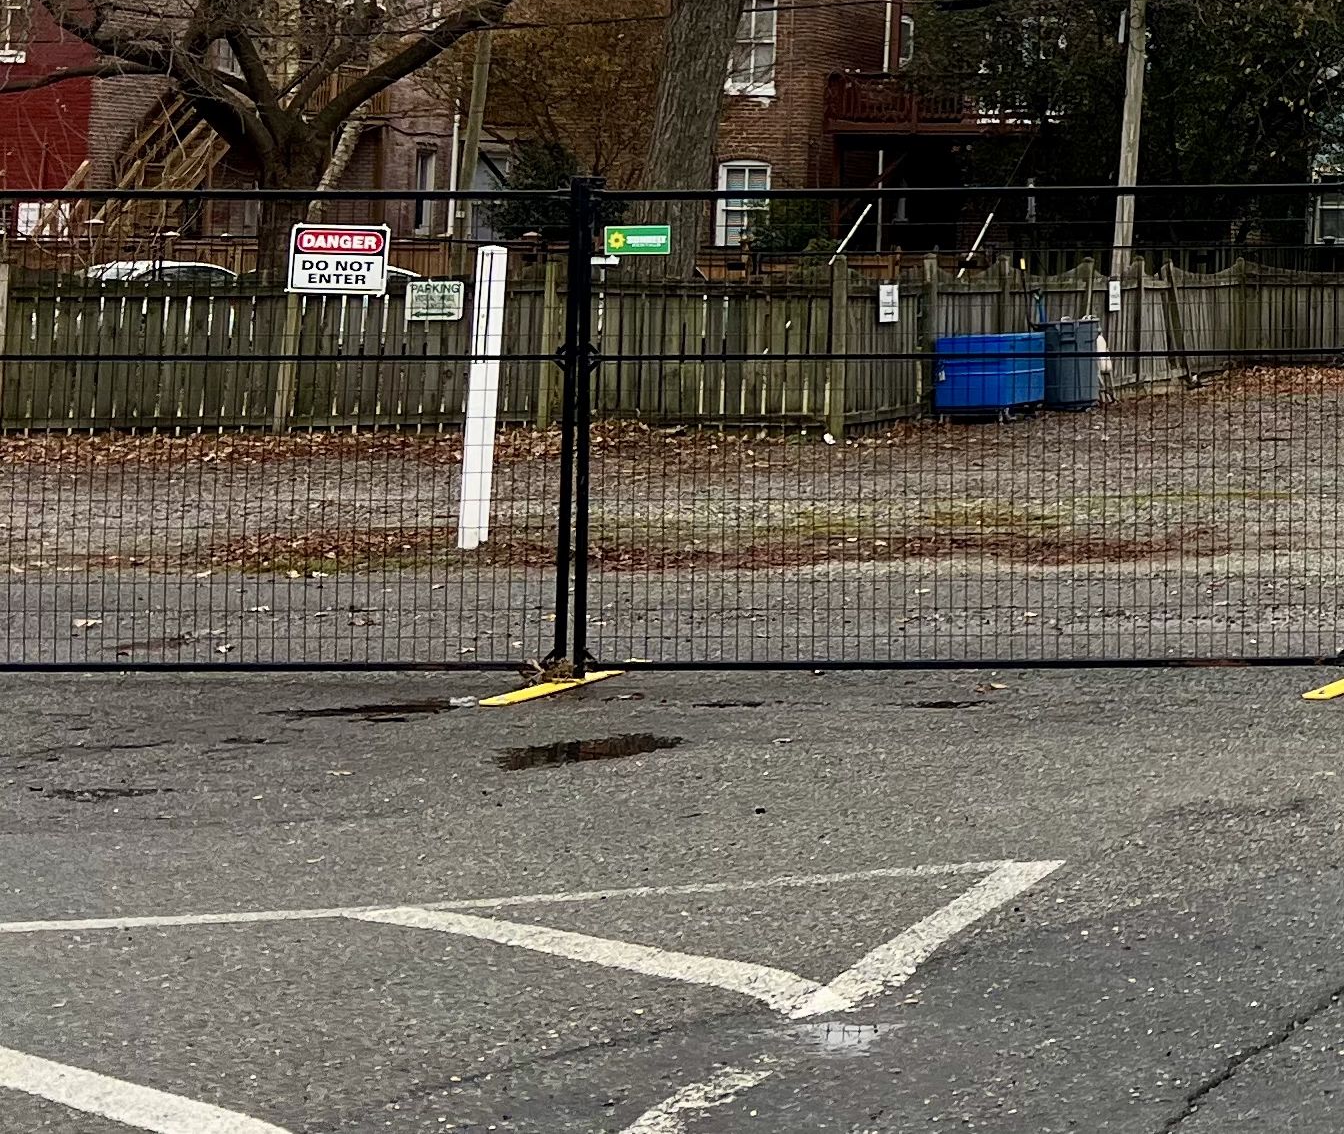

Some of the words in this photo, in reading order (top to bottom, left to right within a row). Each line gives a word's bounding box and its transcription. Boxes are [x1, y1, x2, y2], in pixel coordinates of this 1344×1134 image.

[302, 235, 378, 250] DANGER
[302, 260, 329, 271] DO
[335, 260, 375, 272] NOT
[308, 273, 366, 285] ENTER
[411, 284, 461, 294] PARKING
